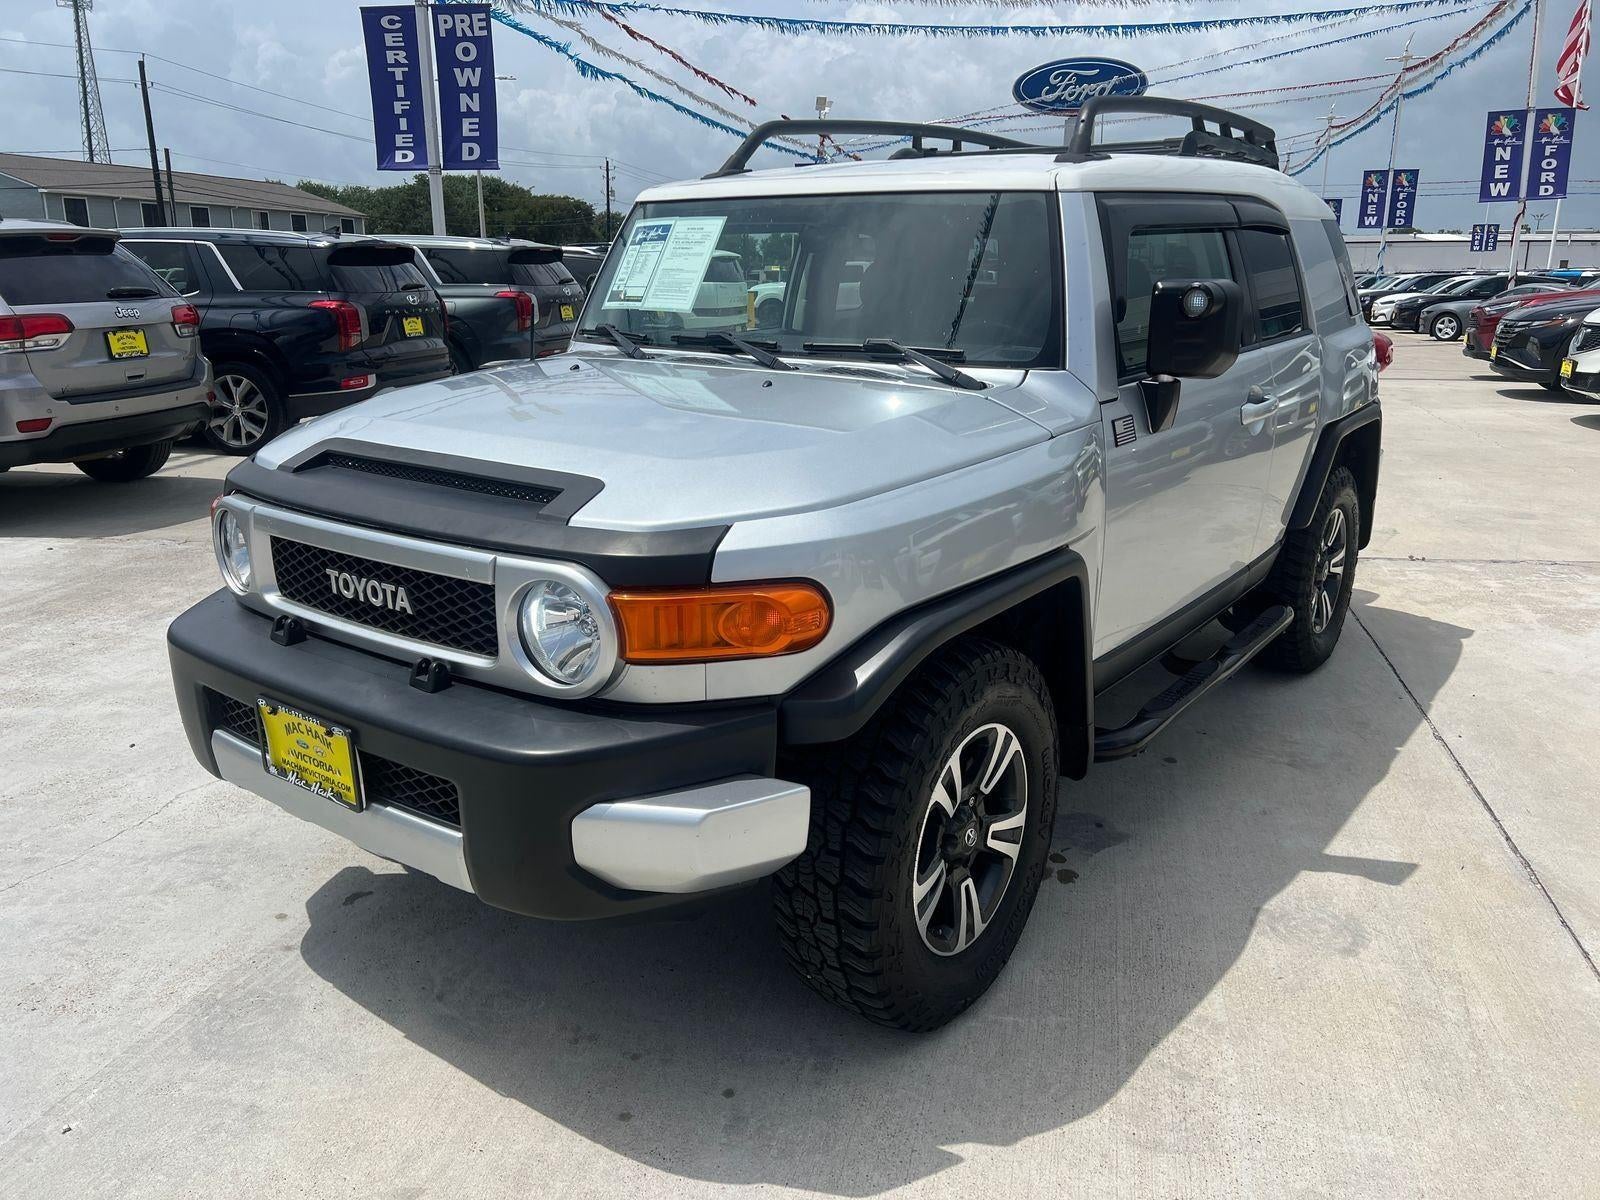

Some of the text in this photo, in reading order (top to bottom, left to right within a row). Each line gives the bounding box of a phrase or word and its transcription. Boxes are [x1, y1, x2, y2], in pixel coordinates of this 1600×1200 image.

[437, 13, 488, 38] PRE
[380, 15, 415, 163] CERTIFIED
[453, 42, 482, 161] OWNED
[1041, 69, 1117, 102] Ford
[1489, 146, 1512, 197] NEW
[1539, 145, 1558, 196] FORD
[1364, 193, 1378, 226] NEW
[1395, 192, 1408, 226] FORD
[115, 307, 140, 319] Jeep
[326, 568, 414, 615] TOYOTA
[285, 722, 304, 737] MAC
